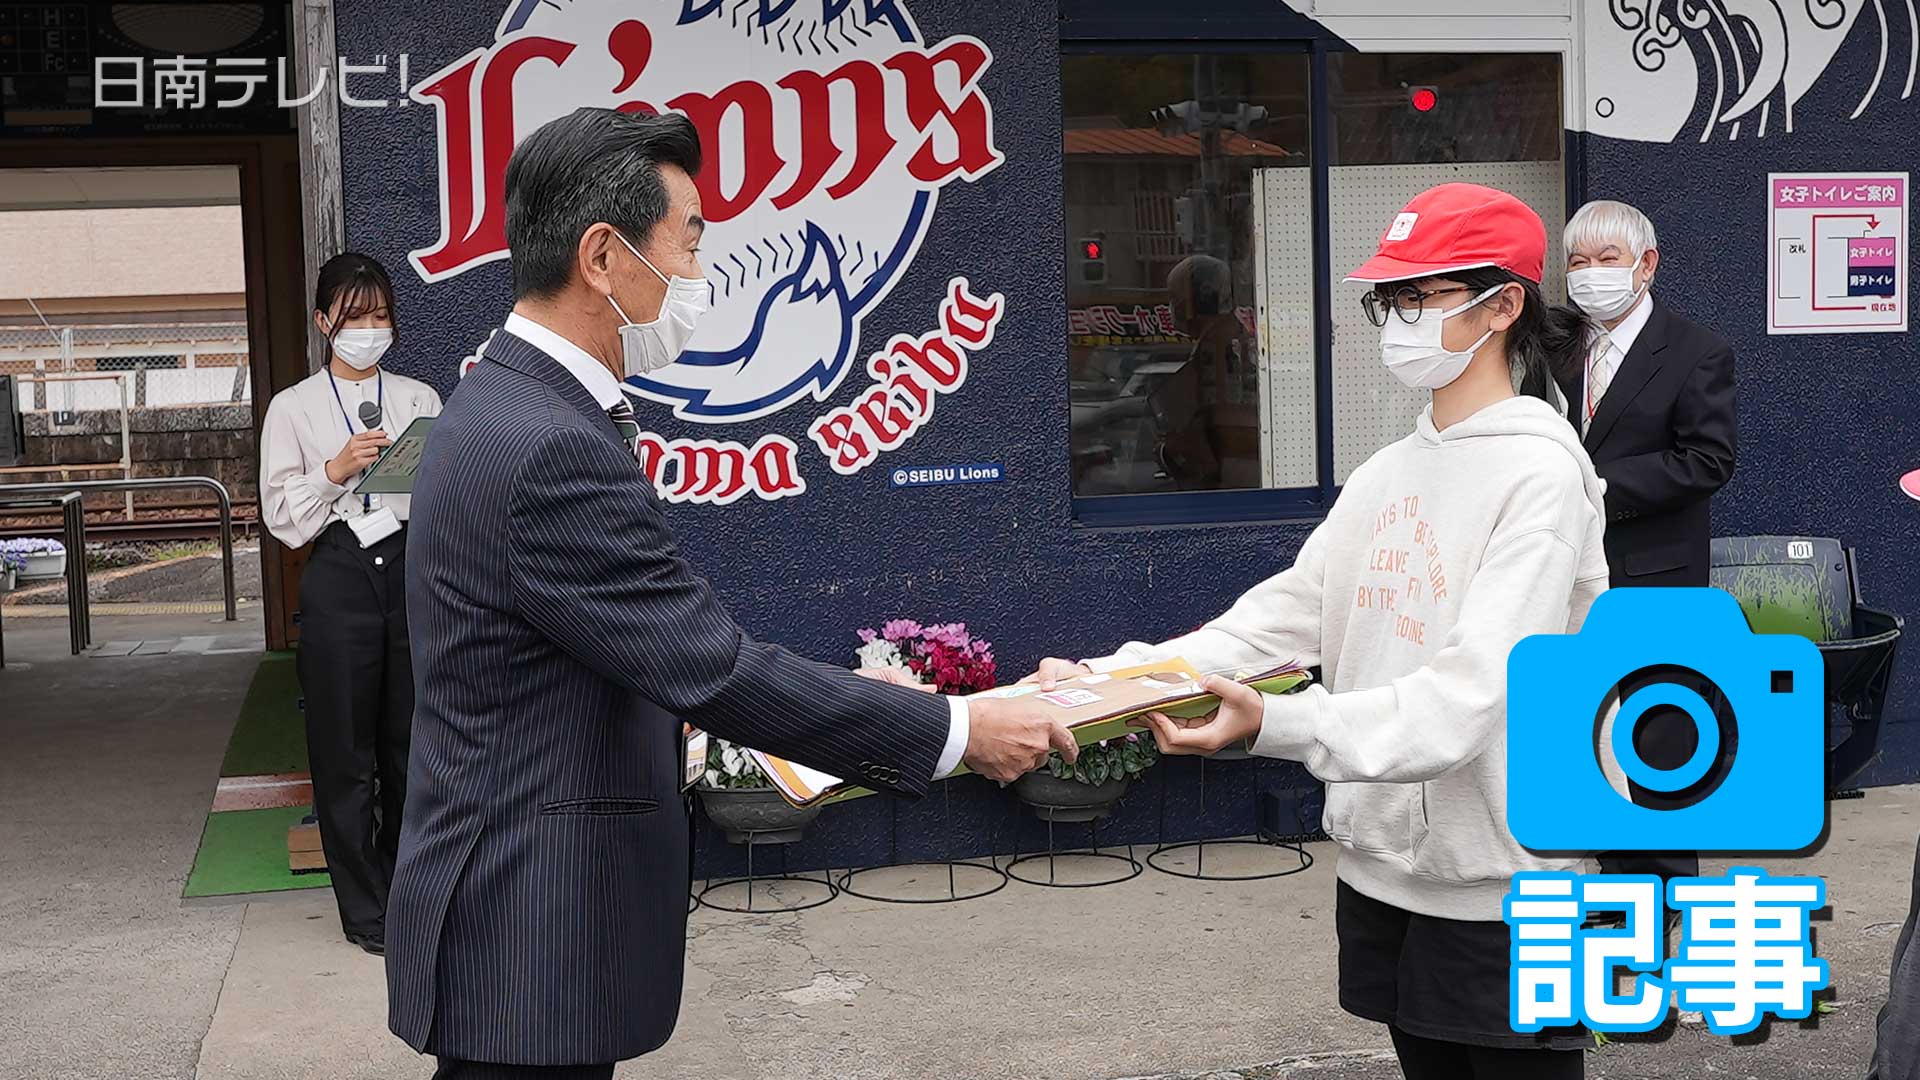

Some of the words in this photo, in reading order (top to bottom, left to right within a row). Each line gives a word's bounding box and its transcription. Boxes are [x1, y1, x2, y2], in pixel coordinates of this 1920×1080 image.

[1780, 186, 1896, 203] 女子トイレご案内
[1850, 247, 1893, 258] 女子トイレ
[1850, 275, 1893, 286] 男子トイレ
[960, 467, 999, 480] Lions
[1371, 503, 1397, 541] AYS
[1403, 495, 1420, 519] TO
[1792, 543, 1810, 557] 101
[1369, 548, 1410, 574] LEAVE
[1357, 585, 1374, 609] BY
